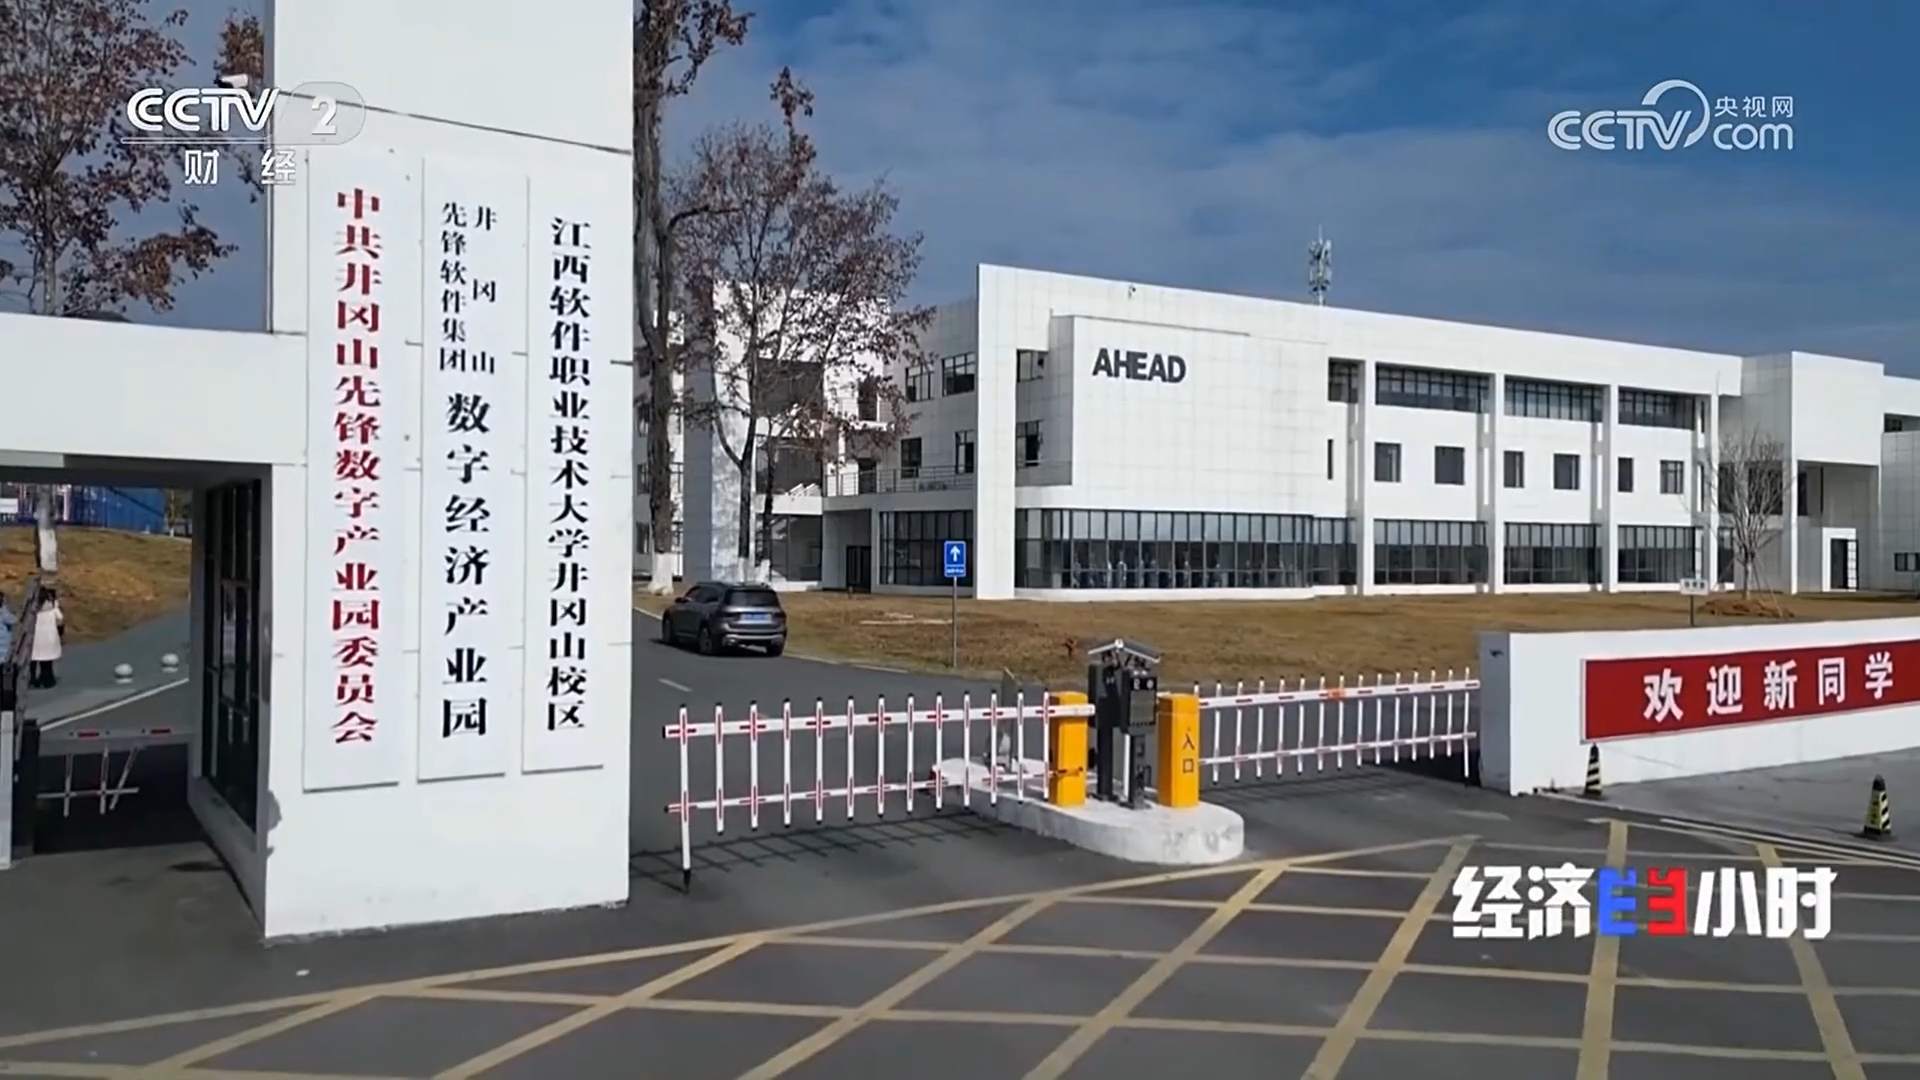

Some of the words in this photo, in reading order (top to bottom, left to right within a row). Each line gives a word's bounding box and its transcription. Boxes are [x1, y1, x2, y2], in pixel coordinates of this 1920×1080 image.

[440, 201, 467, 373] 先锋软件集团
[472, 206, 497, 374] 井冈山
[1092, 347, 1187, 383] AHEAD
[331, 188, 381, 744] 中共井冈山先锋数字产业园委员会
[547, 217, 592, 731] 江西软件职业技术大学井冈山校区
[442, 393, 491, 738] 数字经济产业园
[1182, 732, 1195, 774] 入口
[1643, 651, 1894, 723] 欢迎新同学
